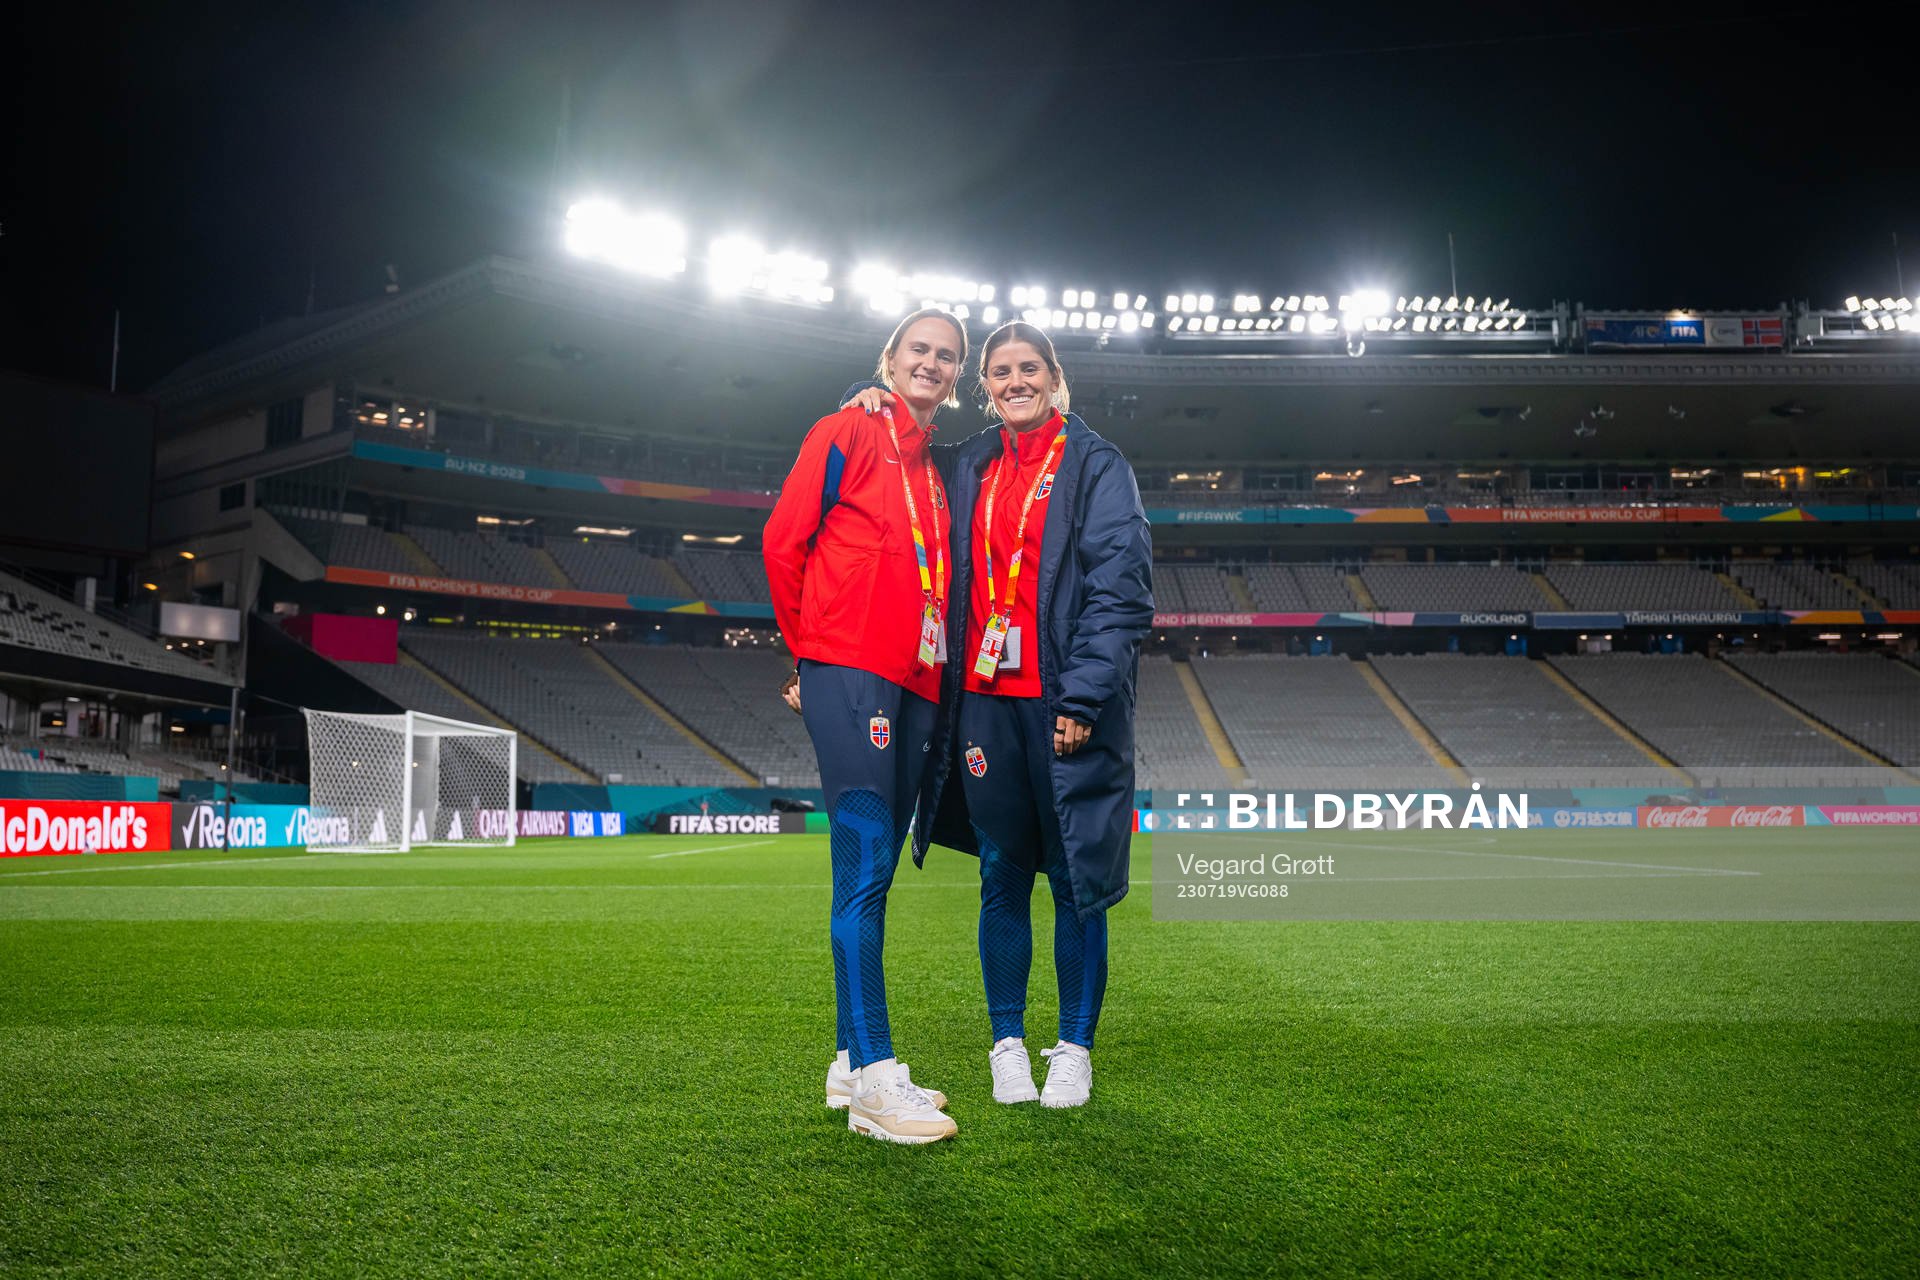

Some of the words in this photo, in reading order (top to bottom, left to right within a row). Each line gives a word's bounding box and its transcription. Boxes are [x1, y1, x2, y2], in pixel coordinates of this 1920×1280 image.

[1671, 326, 1698, 337] FIFA
[1177, 511, 1242, 521] #FIFAWWC
[1502, 511, 1527, 520] FIFA
[1530, 511, 1586, 520] WOMEN'S
[1590, 511, 1632, 520] WORLD
[1636, 511, 1661, 520] CUP
[389, 575, 416, 588] FIFA
[418, 578, 478, 594] WOMEN'S
[481, 585, 525, 597] WORLD
[527, 588, 552, 600] CUP
[1153, 615, 1178, 625] OND
[1182, 615, 1252, 625] GREATNESS
[1460, 614, 1526, 624] AUCKLAND
[521, 811, 566, 835] AIRWAYS
[571, 812, 594, 836] VISA
[601, 812, 621, 835] VISA
[670, 814, 713, 833] FIFA
[715, 814, 780, 833] STORE
[1833, 812, 1860, 823] FIFA
[1860, 812, 1918, 823] WOMEN'S
[297, 807, 349, 844] Rexona
